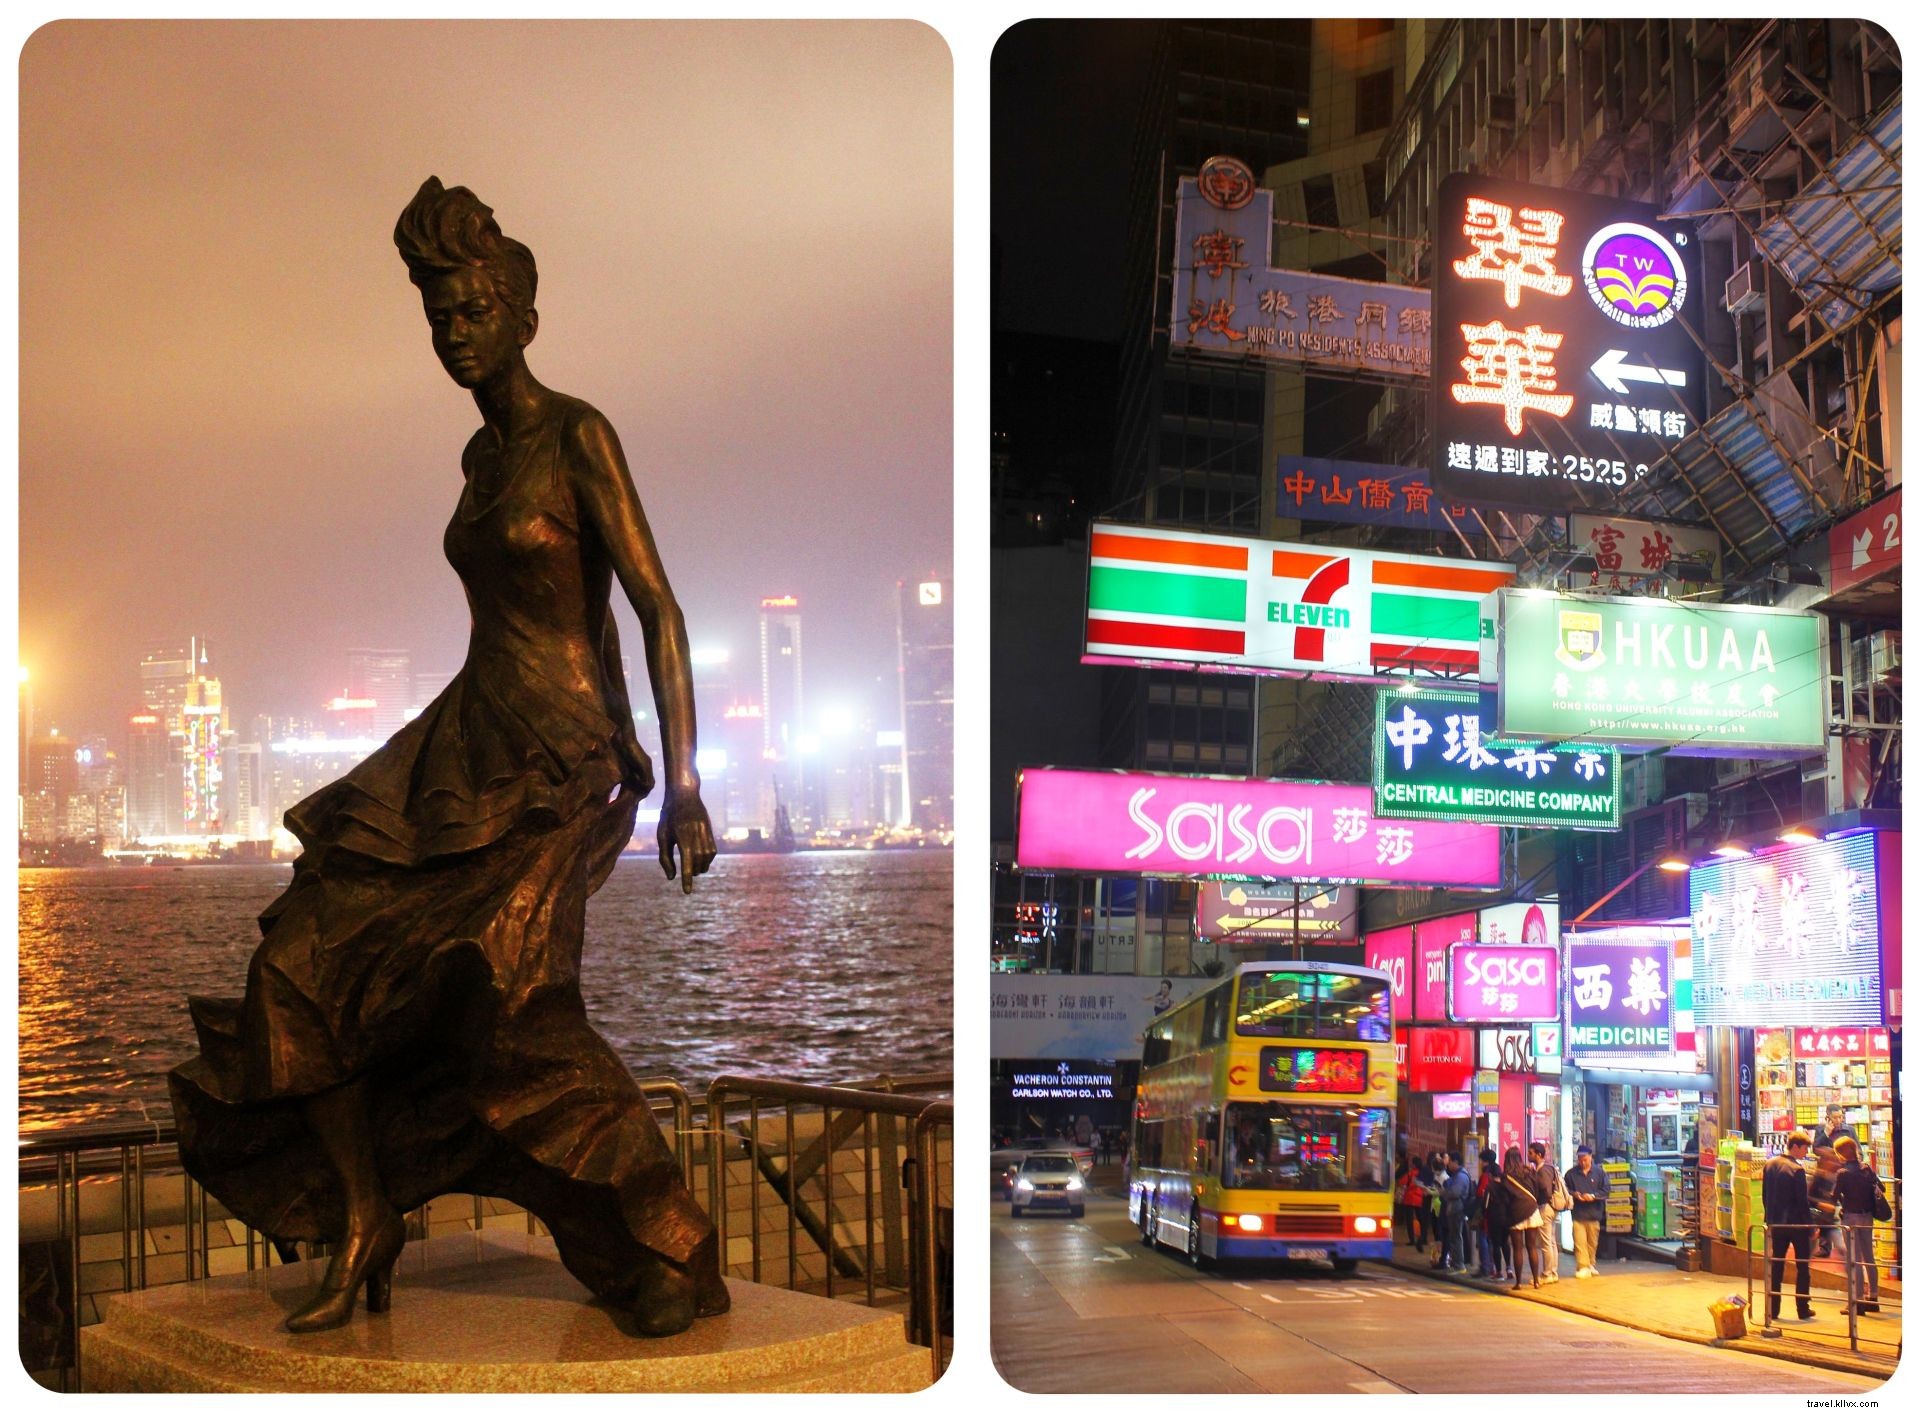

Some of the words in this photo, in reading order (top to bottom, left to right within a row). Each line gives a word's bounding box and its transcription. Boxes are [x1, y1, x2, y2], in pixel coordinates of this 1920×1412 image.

[1247, 326, 1275, 345] NING
[1279, 330, 1295, 348] PO
[1299, 334, 1361, 357] RESIDENTS
[1615, 620, 1776, 673] HKUAA
[1552, 701, 1581, 711] HONG
[1584, 702, 1612, 713] KONG
[1615, 704, 1674, 715] UNIVERSITY
[1676, 706, 1713, 717] ALUMNI
[1716, 708, 1779, 719] ASSOCIATION
[1384, 783, 1459, 804] CENTRAL
[1461, 787, 1535, 808] MEDICINE
[1538, 791, 1613, 812] COMPANY
[1573, 956, 1667, 1015] 西藥
[1571, 1027, 1669, 1046] MEDICINE
[1014, 1074, 1059, 1085] VACHERON
[1061, 1074, 1112, 1086] CONSTANTIN
[1012, 1088, 1049, 1098] CARLSON
[1050, 1089, 1079, 1098] WATCH
[1097, 1089, 1113, 1098] LTD.
